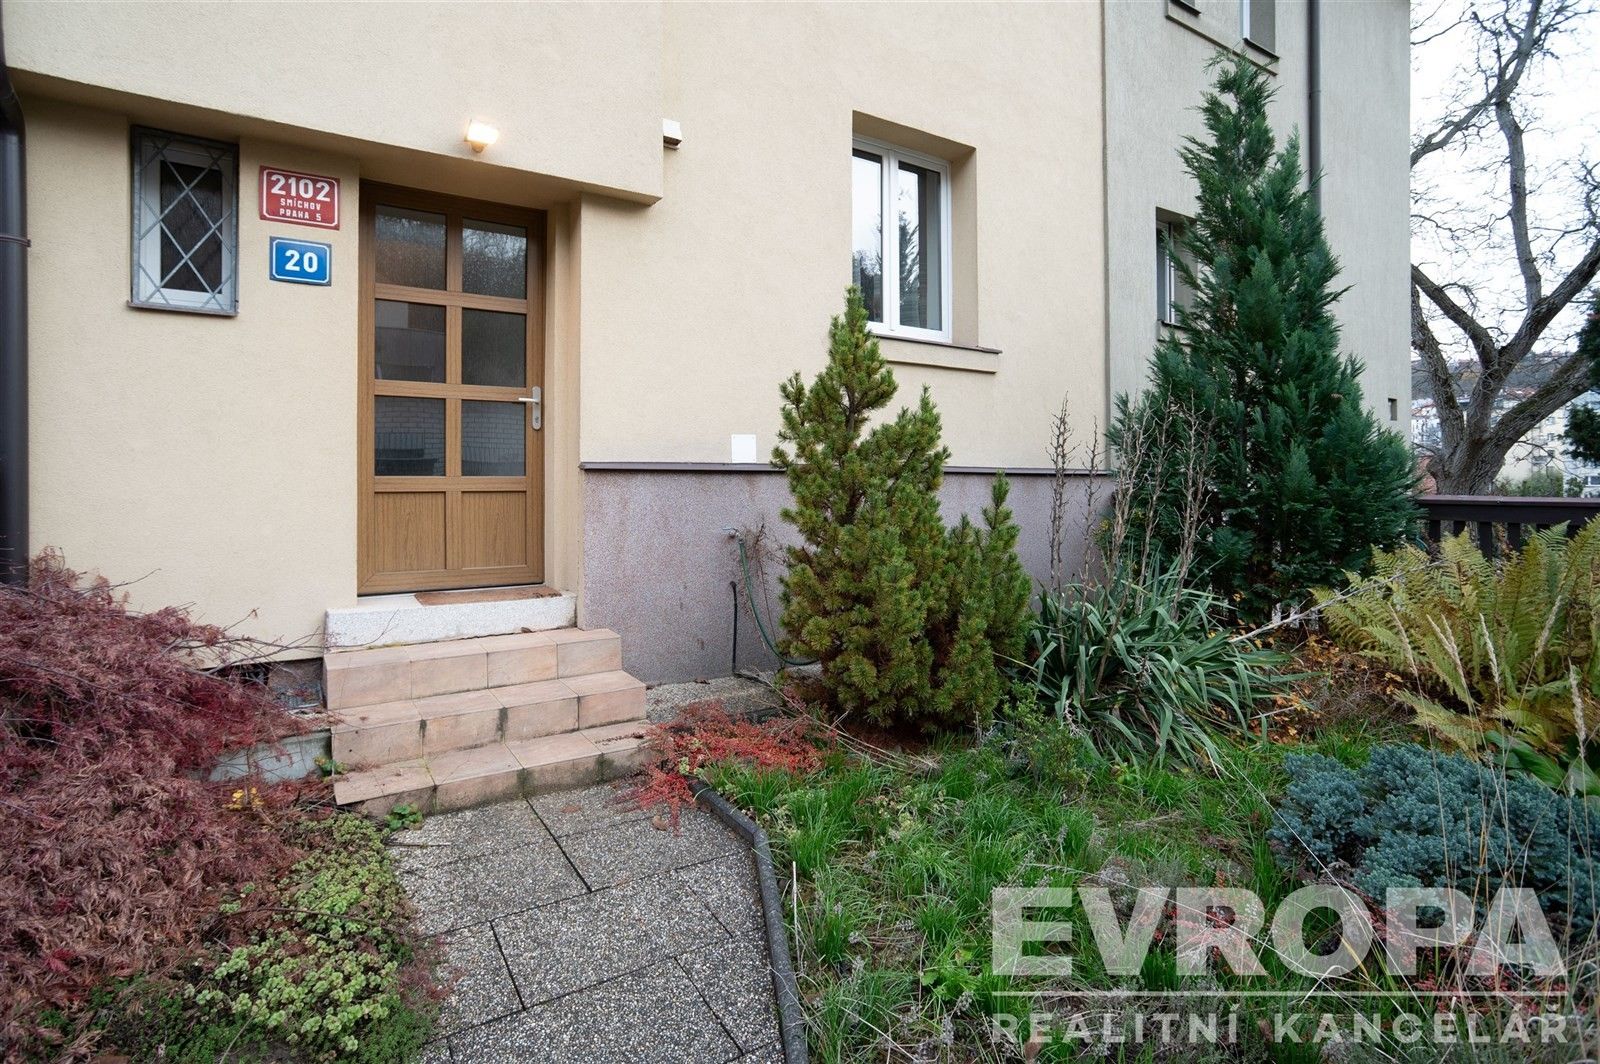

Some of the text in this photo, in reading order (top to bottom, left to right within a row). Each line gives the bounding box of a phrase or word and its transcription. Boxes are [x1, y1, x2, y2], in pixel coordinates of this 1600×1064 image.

[271, 174, 330, 202] 2102
[280, 198, 321, 210] SMÍCHOV
[280, 208, 321, 221] PRAHA 5
[285, 249, 318, 273] 20
